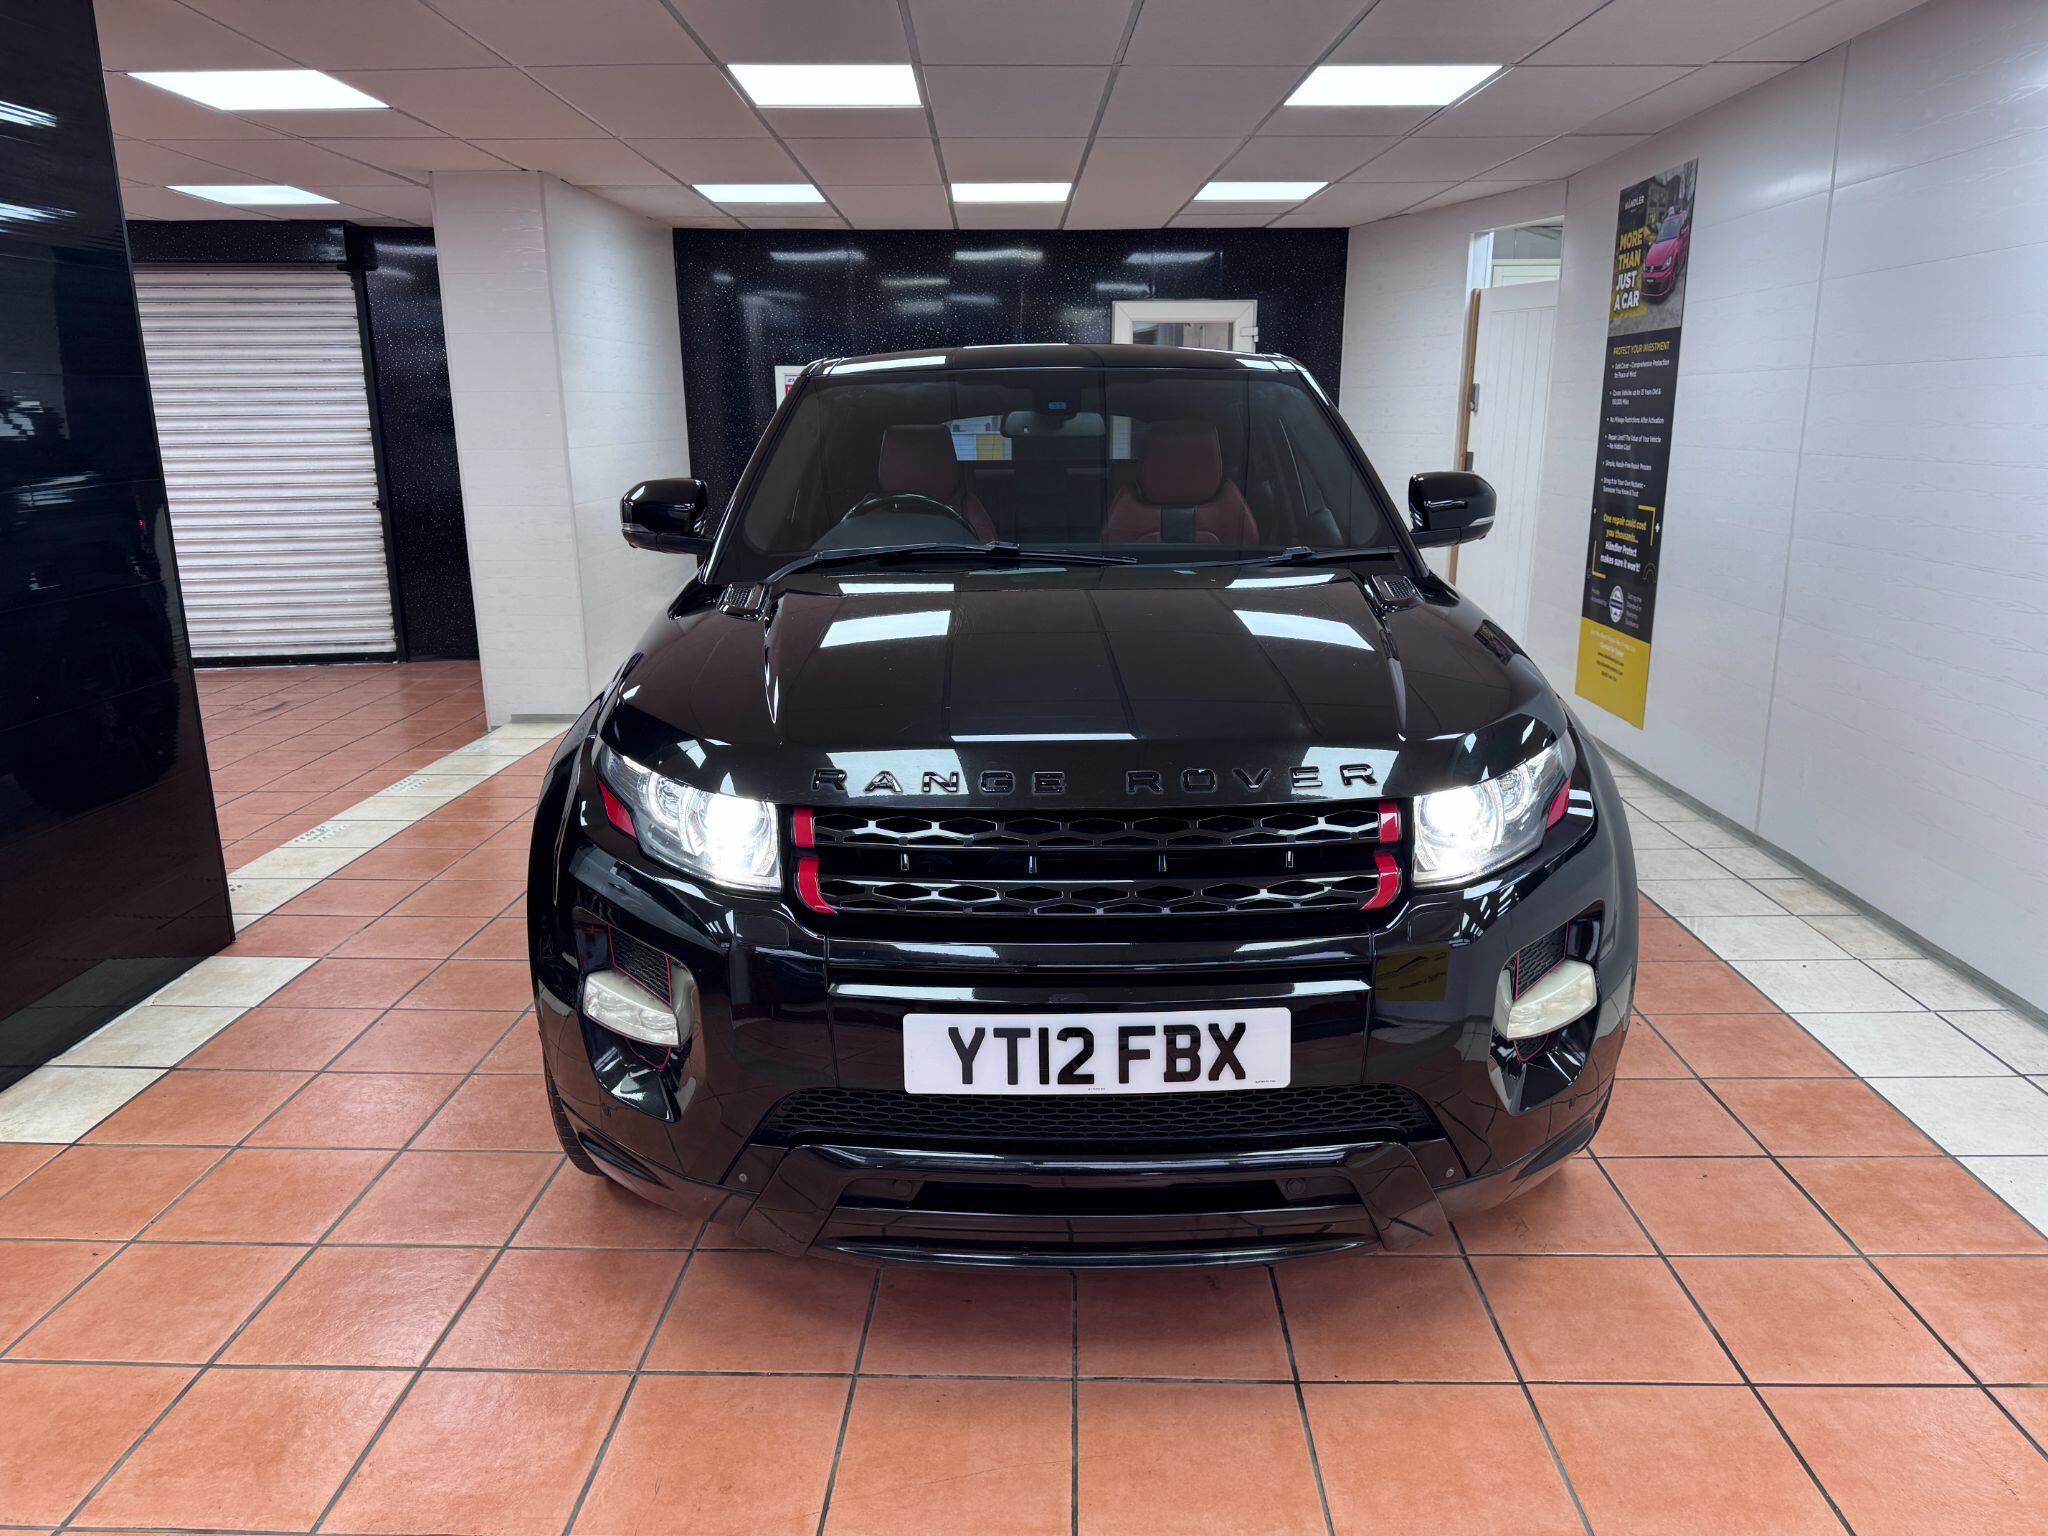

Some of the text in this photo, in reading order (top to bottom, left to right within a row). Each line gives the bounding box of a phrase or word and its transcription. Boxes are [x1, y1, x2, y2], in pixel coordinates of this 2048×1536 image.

[1620, 228, 1644, 250] MORE
[1618, 249, 1641, 270] THAN
[1616, 271, 1637, 291] JUST
[1614, 290, 1640, 311] A CAR
[1604, 514, 1647, 530] One repair could cost
[1606, 529, 1615, 538] you
[1622, 545, 1637, 556] Protect
[1600, 554, 1614, 565] makes
[1615, 558, 1623, 568] sure
[812, 763, 1378, 795] RANGE ROVER
[948, 1022, 1247, 1085] YT12 FBX
